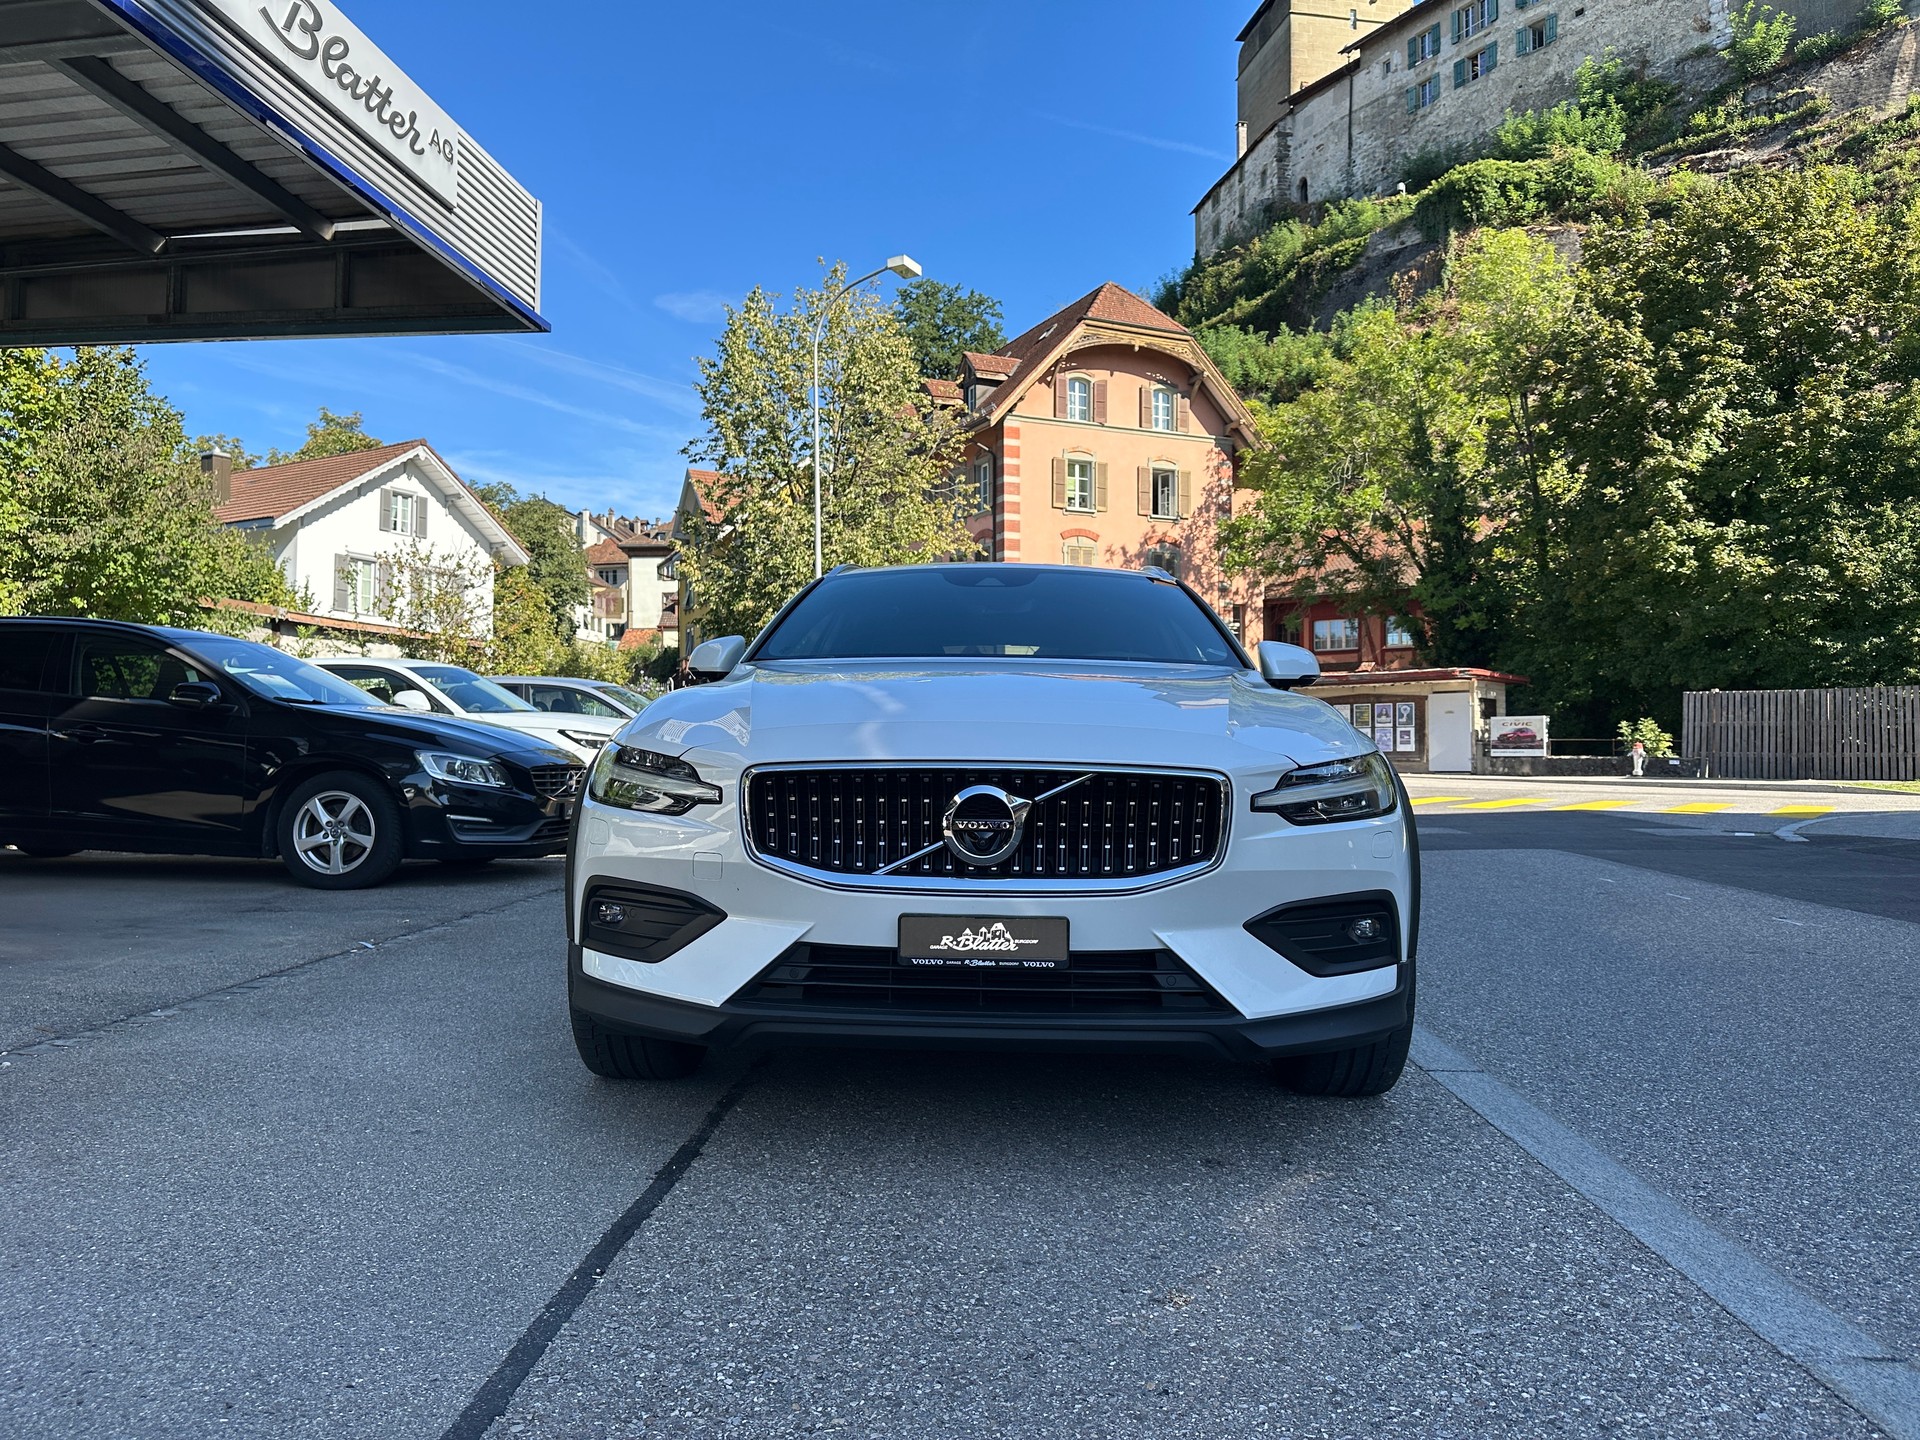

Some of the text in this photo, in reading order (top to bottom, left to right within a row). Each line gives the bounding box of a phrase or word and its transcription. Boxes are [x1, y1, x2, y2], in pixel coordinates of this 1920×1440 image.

[258, 0, 454, 165] Blatter AG
[955, 820, 1010, 829] VOLVO
[911, 958, 944, 966] VOLVO
